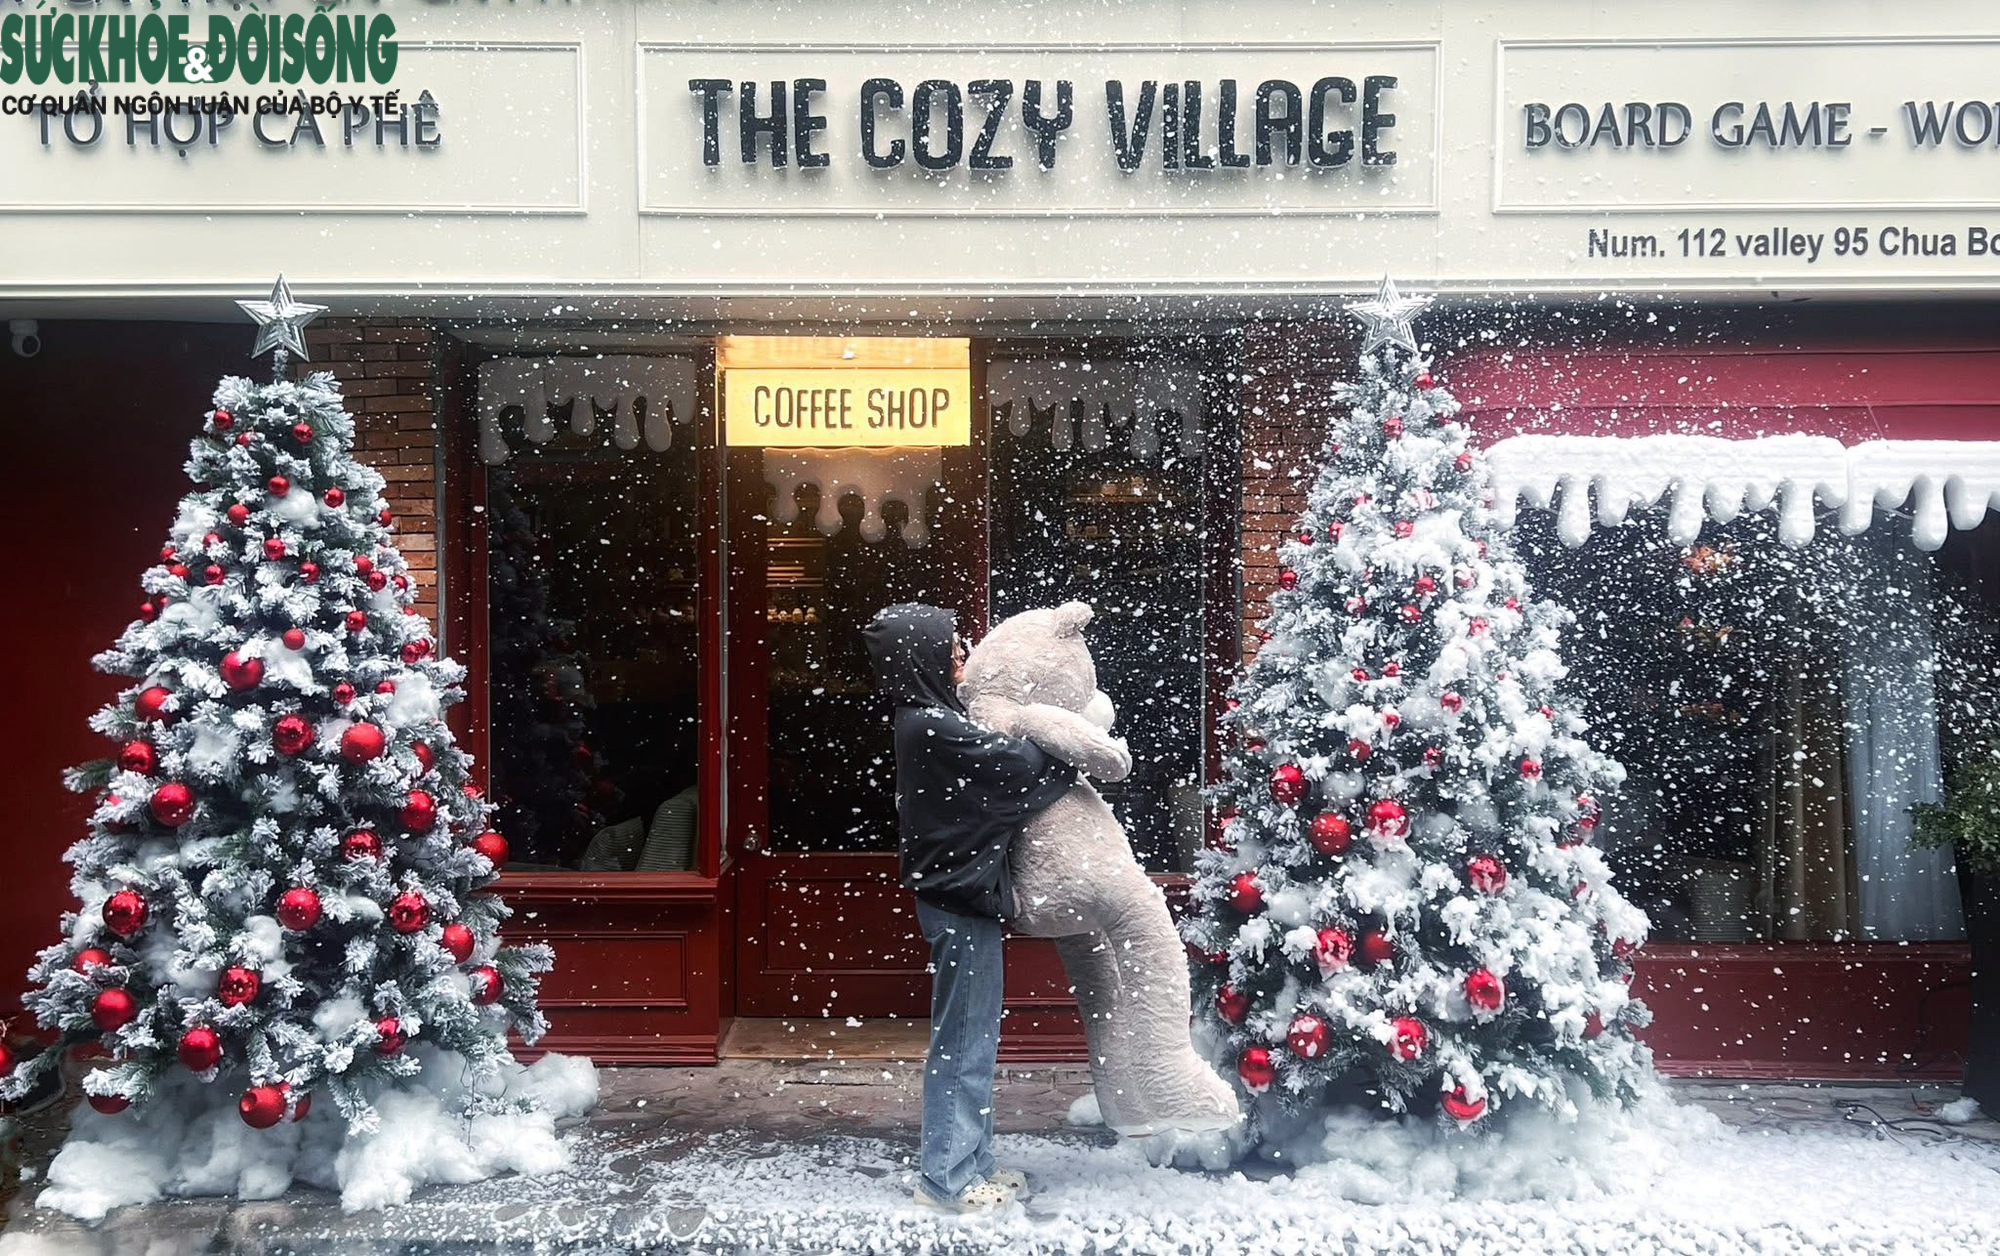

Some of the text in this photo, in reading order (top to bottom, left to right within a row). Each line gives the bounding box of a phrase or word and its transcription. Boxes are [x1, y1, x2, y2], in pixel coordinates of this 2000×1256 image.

[343, 89, 441, 146] PHÊ
[688, 75, 1399, 170] THE COZY VILLAGE
[1524, 103, 1692, 147] BOARD
[1712, 101, 1852, 146] GAME
[1904, 100, 2000, 146] WO
[1588, 229, 1665, 257] Num.
[1677, 229, 1726, 256] 112
[1736, 227, 1824, 264] valley
[1834, 228, 1868, 256] 95
[1879, 226, 1956, 256] Chua
[754, 386, 950, 429] COFFEE SHOP
